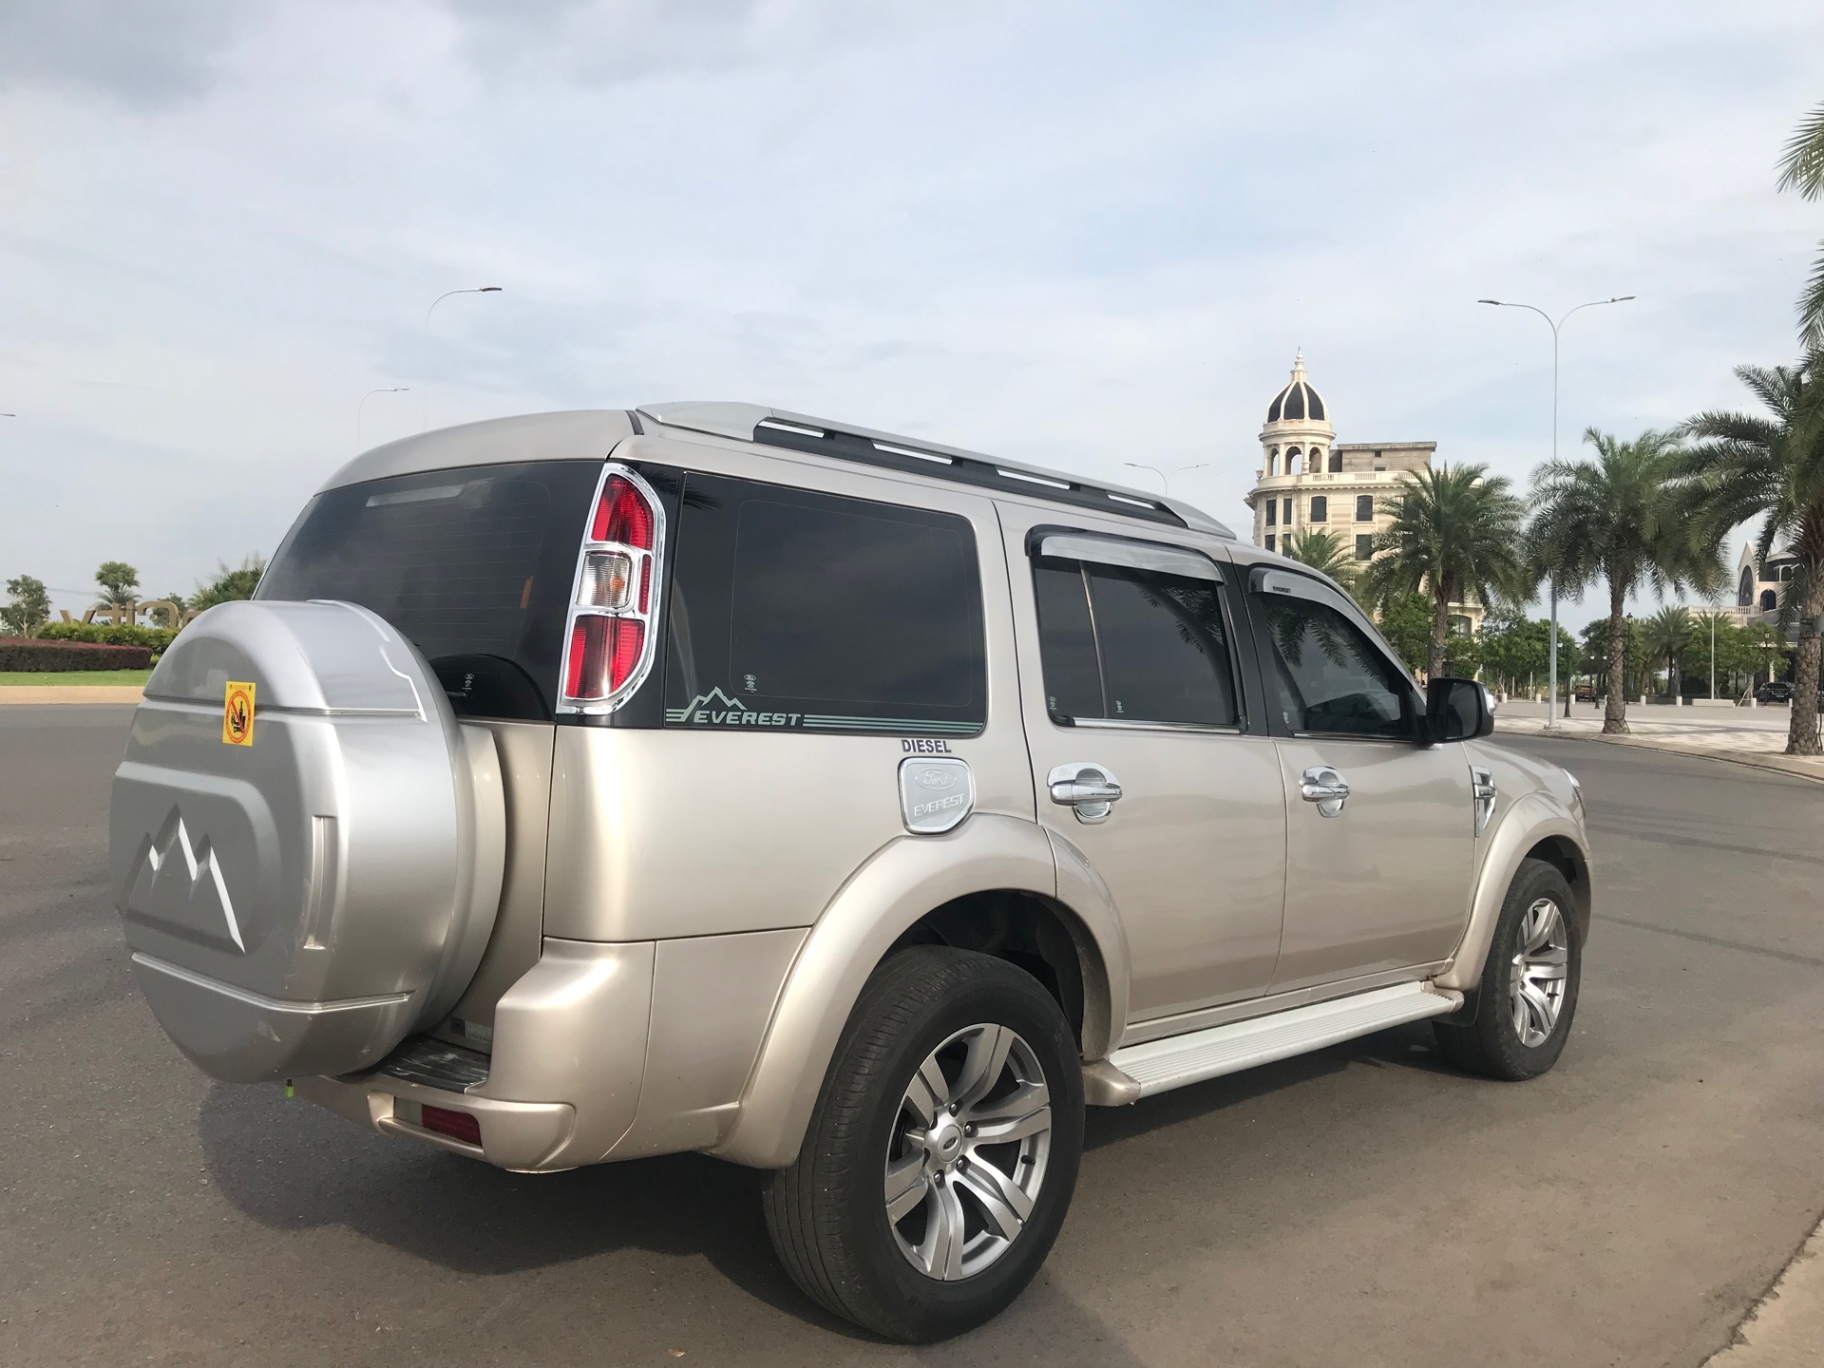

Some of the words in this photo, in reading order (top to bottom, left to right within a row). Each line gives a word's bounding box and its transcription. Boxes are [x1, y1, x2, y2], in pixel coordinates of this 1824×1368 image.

[693, 709, 802, 726] EVEREST
[901, 739, 952, 753] DIESEL
[923, 770, 950, 786] Ford
[914, 792, 966, 818] EVEREST
